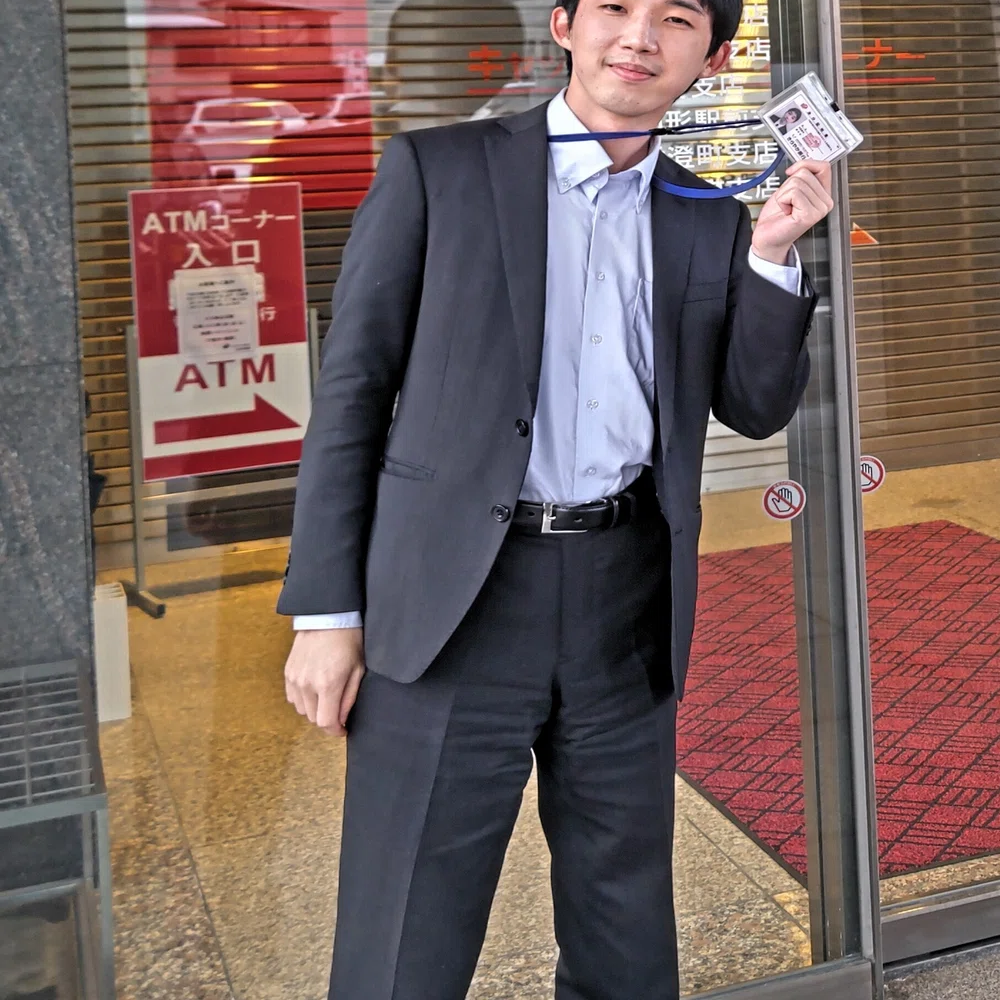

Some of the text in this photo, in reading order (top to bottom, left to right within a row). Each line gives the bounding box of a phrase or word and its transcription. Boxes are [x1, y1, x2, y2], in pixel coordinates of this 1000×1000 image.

[660, 141, 779, 168] 澄町支店
[141, 209, 296, 236] ATMコーナー
[182, 240, 261, 268] 入口
[174, 353, 276, 392] ATM
